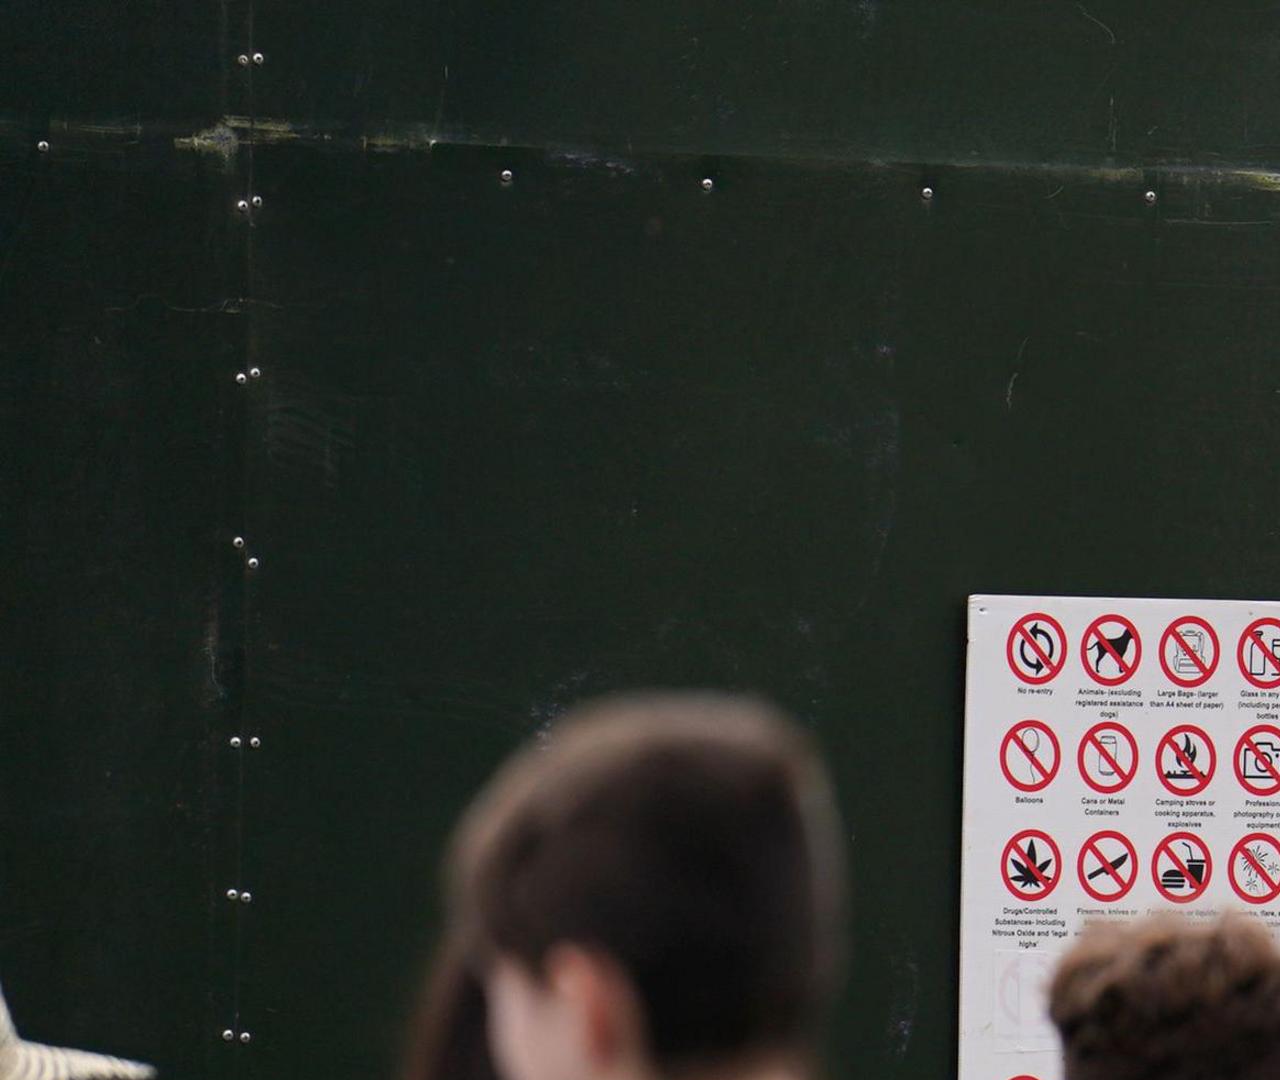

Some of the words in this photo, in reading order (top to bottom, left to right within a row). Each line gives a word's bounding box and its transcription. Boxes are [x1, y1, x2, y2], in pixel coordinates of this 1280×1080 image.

[1157, 690, 1176, 698] Large
[1198, 690, 1218, 699] (larger
[1240, 690, 1258, 698] Glass
[1203, 702, 1224, 710] paper)
[1238, 702, 1270, 710] (including
[1155, 799, 1184, 807] Camping
[1233, 811, 1274, 819] photography
[1036, 919, 1066, 927] including
